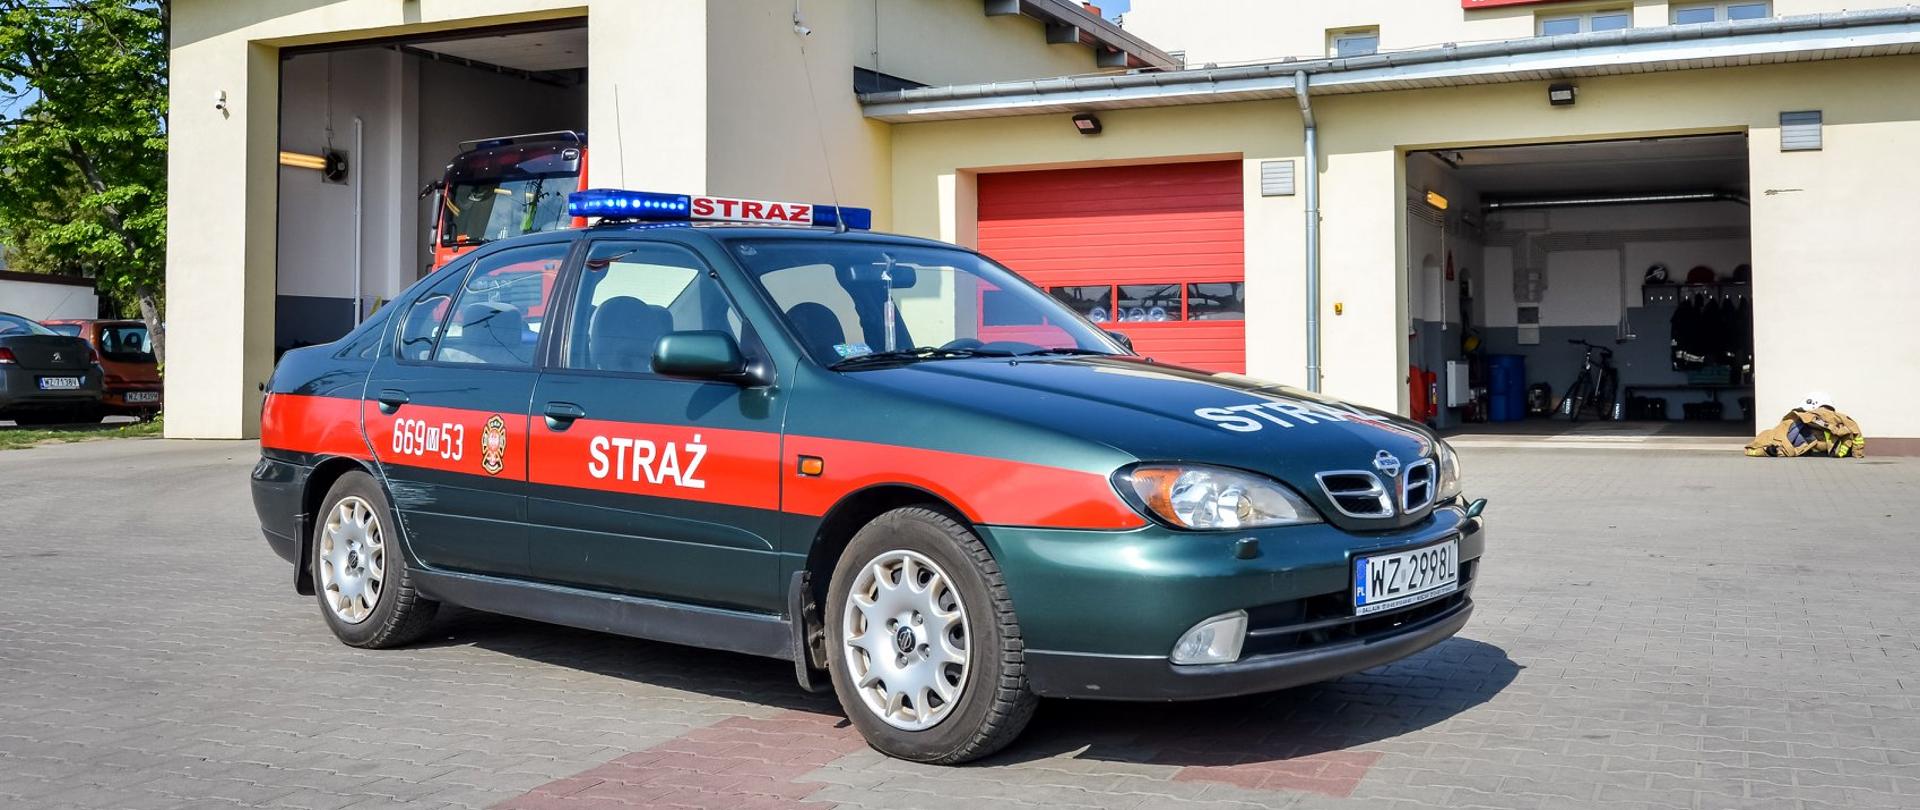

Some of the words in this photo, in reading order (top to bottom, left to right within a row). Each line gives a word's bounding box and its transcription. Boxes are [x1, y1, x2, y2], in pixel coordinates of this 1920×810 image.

[588, 434, 708, 489] STRAŻ
[1357, 586, 1365, 597] PL
[1371, 557, 1402, 598] WZ
[1408, 545, 1456, 591] 2998L
